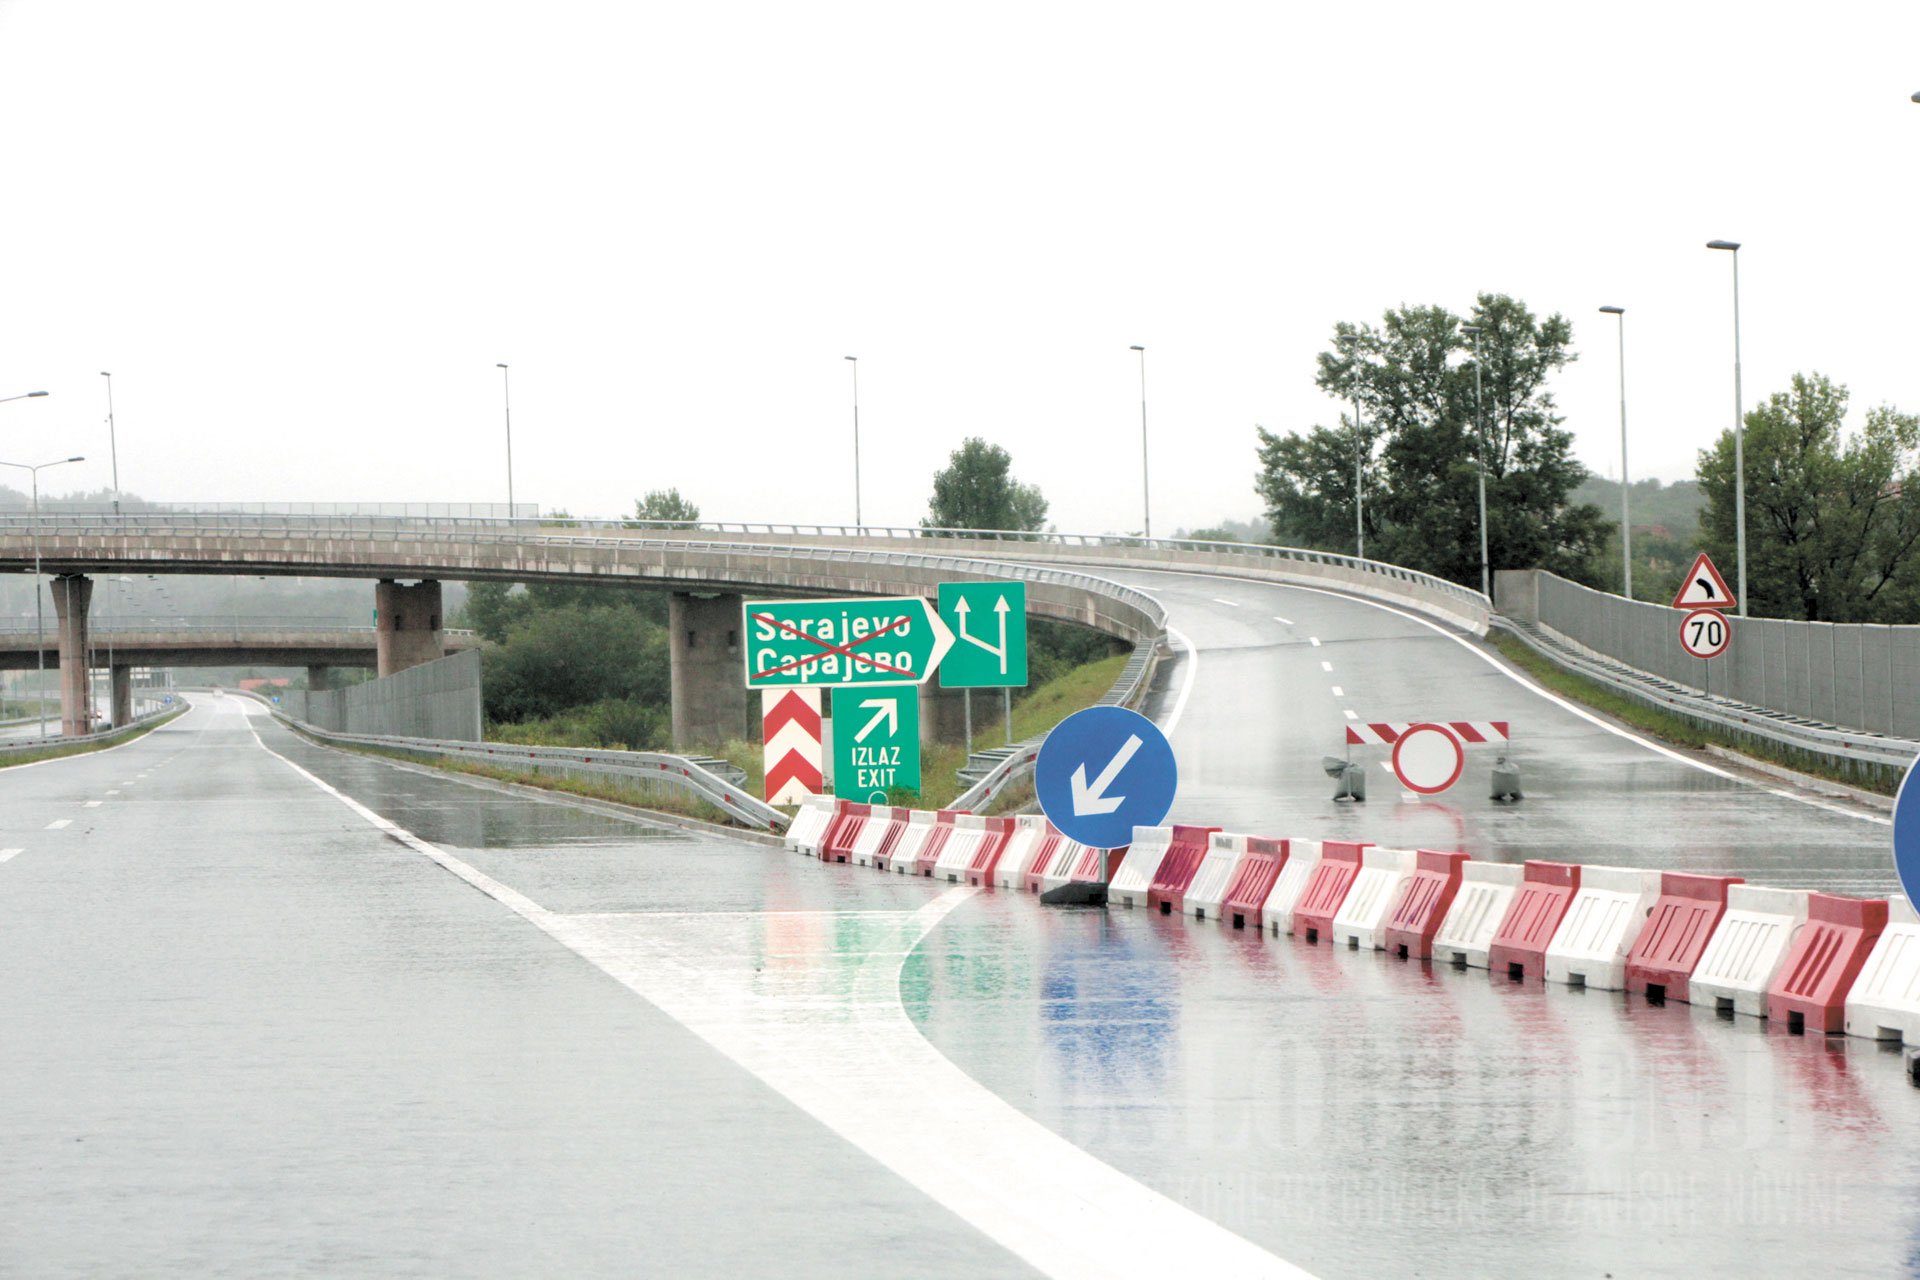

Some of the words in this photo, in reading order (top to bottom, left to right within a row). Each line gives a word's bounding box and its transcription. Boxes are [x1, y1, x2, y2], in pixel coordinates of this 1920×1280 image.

[754, 611, 912, 647] Sarajevo
[1691, 621, 1722, 647] 70
[756, 648, 913, 683] Сарајево
[851, 746, 901, 767] IZLAZ
[857, 768, 896, 788] EXIT
